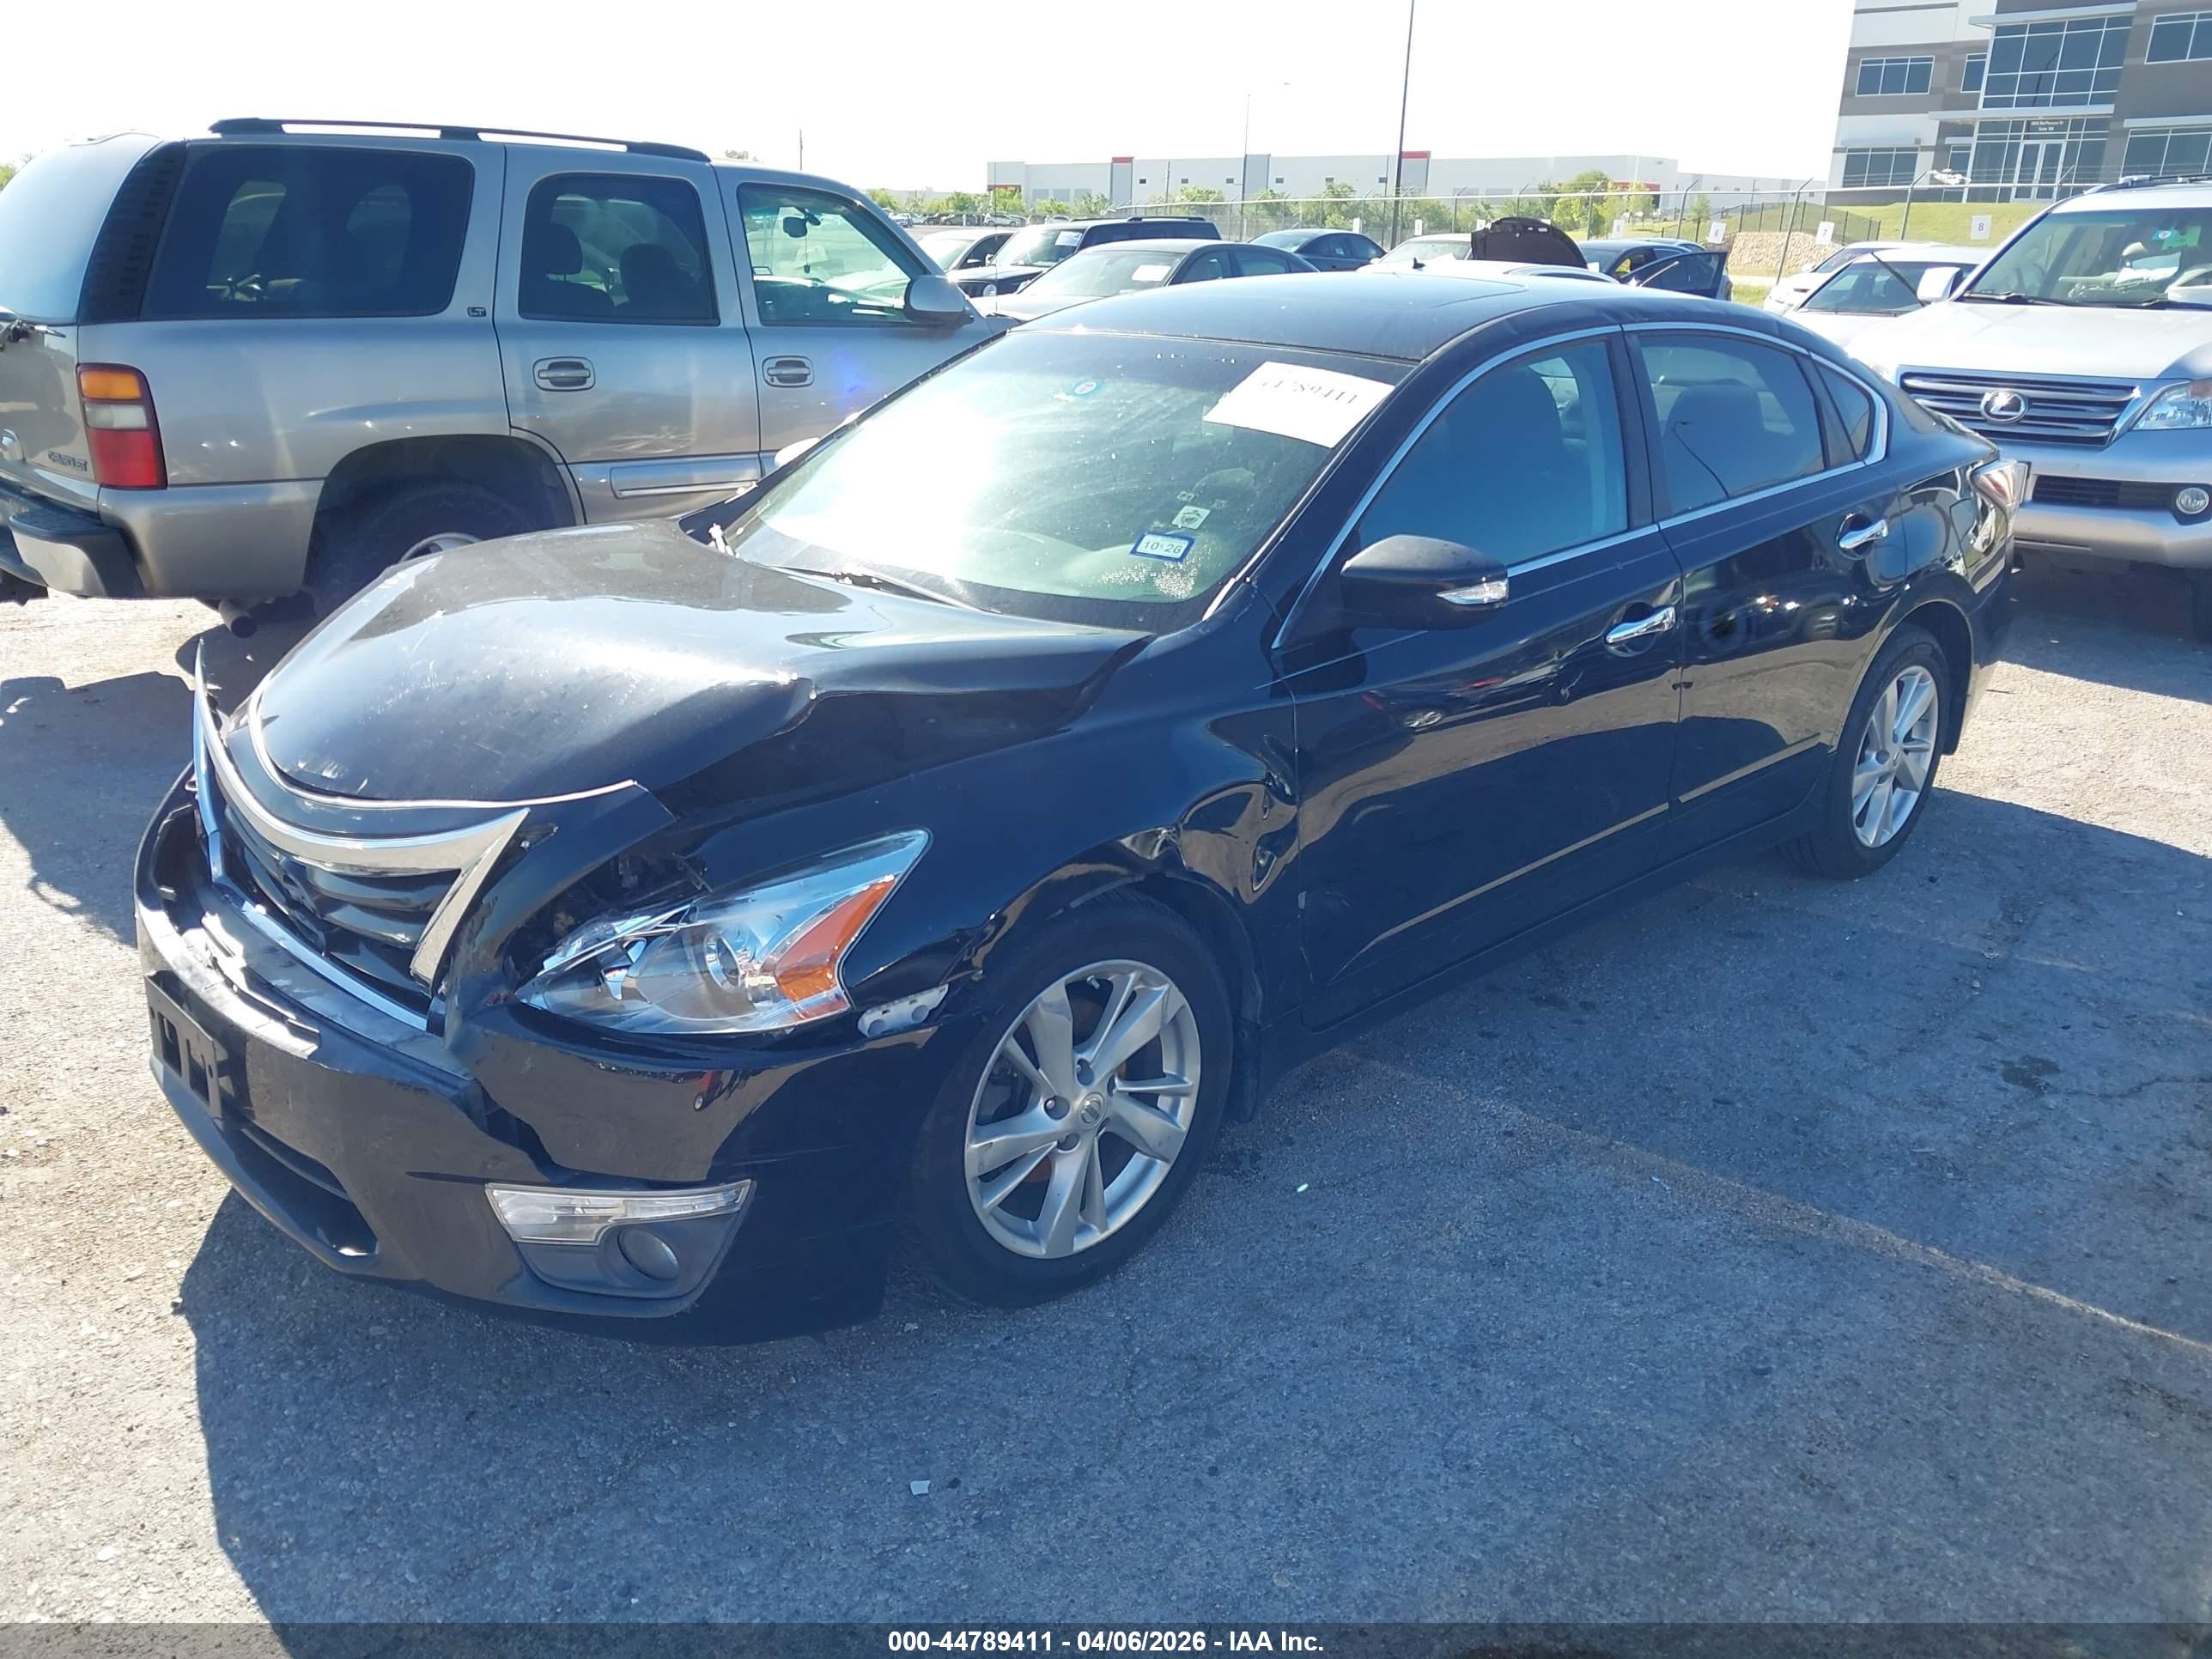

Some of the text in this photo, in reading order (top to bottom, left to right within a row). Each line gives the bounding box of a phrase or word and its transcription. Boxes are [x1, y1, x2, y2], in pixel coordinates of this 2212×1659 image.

[1978, 222, 1984, 232] 8
[1145, 541, 1182, 555] 10 26
